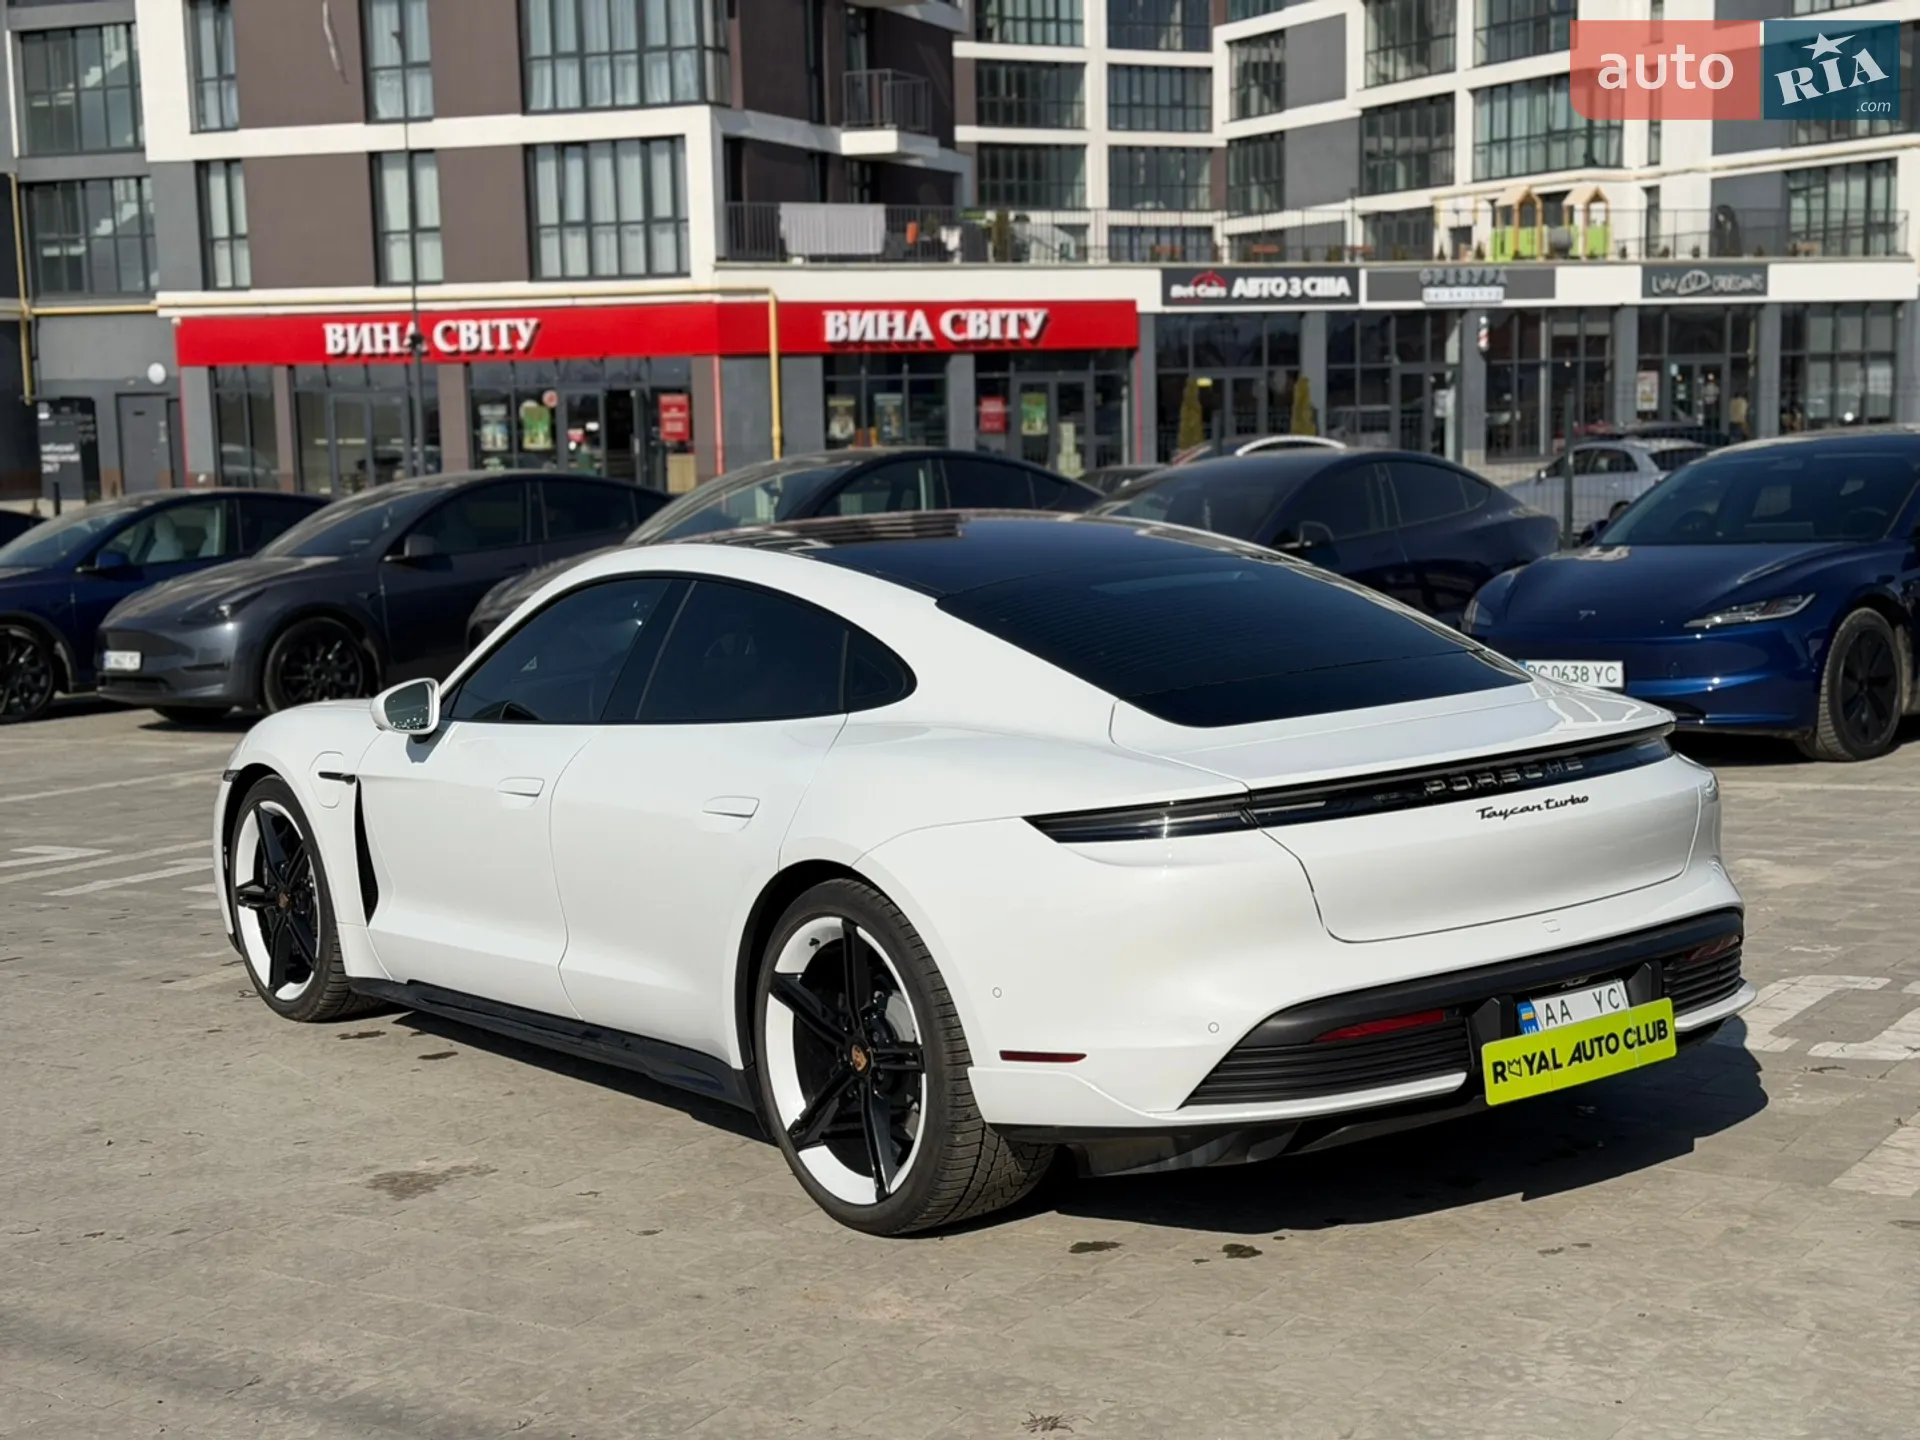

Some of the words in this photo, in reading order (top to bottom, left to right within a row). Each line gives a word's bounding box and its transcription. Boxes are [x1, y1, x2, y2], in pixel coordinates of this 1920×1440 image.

[1231, 276, 1287, 298] АВТО
[1303, 276, 1352, 298] США
[323, 321, 428, 355] ВИНА
[433, 318, 539, 353] СВІТУ
[822, 309, 934, 343] ВИНА
[940, 308, 1048, 342] СВІТУ
[1594, 665, 1617, 683] YC
[1424, 757, 1584, 796] PORSCHE
[1476, 804, 1543, 821] Taycan
[1544, 793, 1590, 810] turbo
[1545, 1000, 1574, 1027] AA
[1592, 988, 1620, 1014] YC
[1567, 1032, 1620, 1067] AUTO
[1623, 1018, 1669, 1050] CLUB
